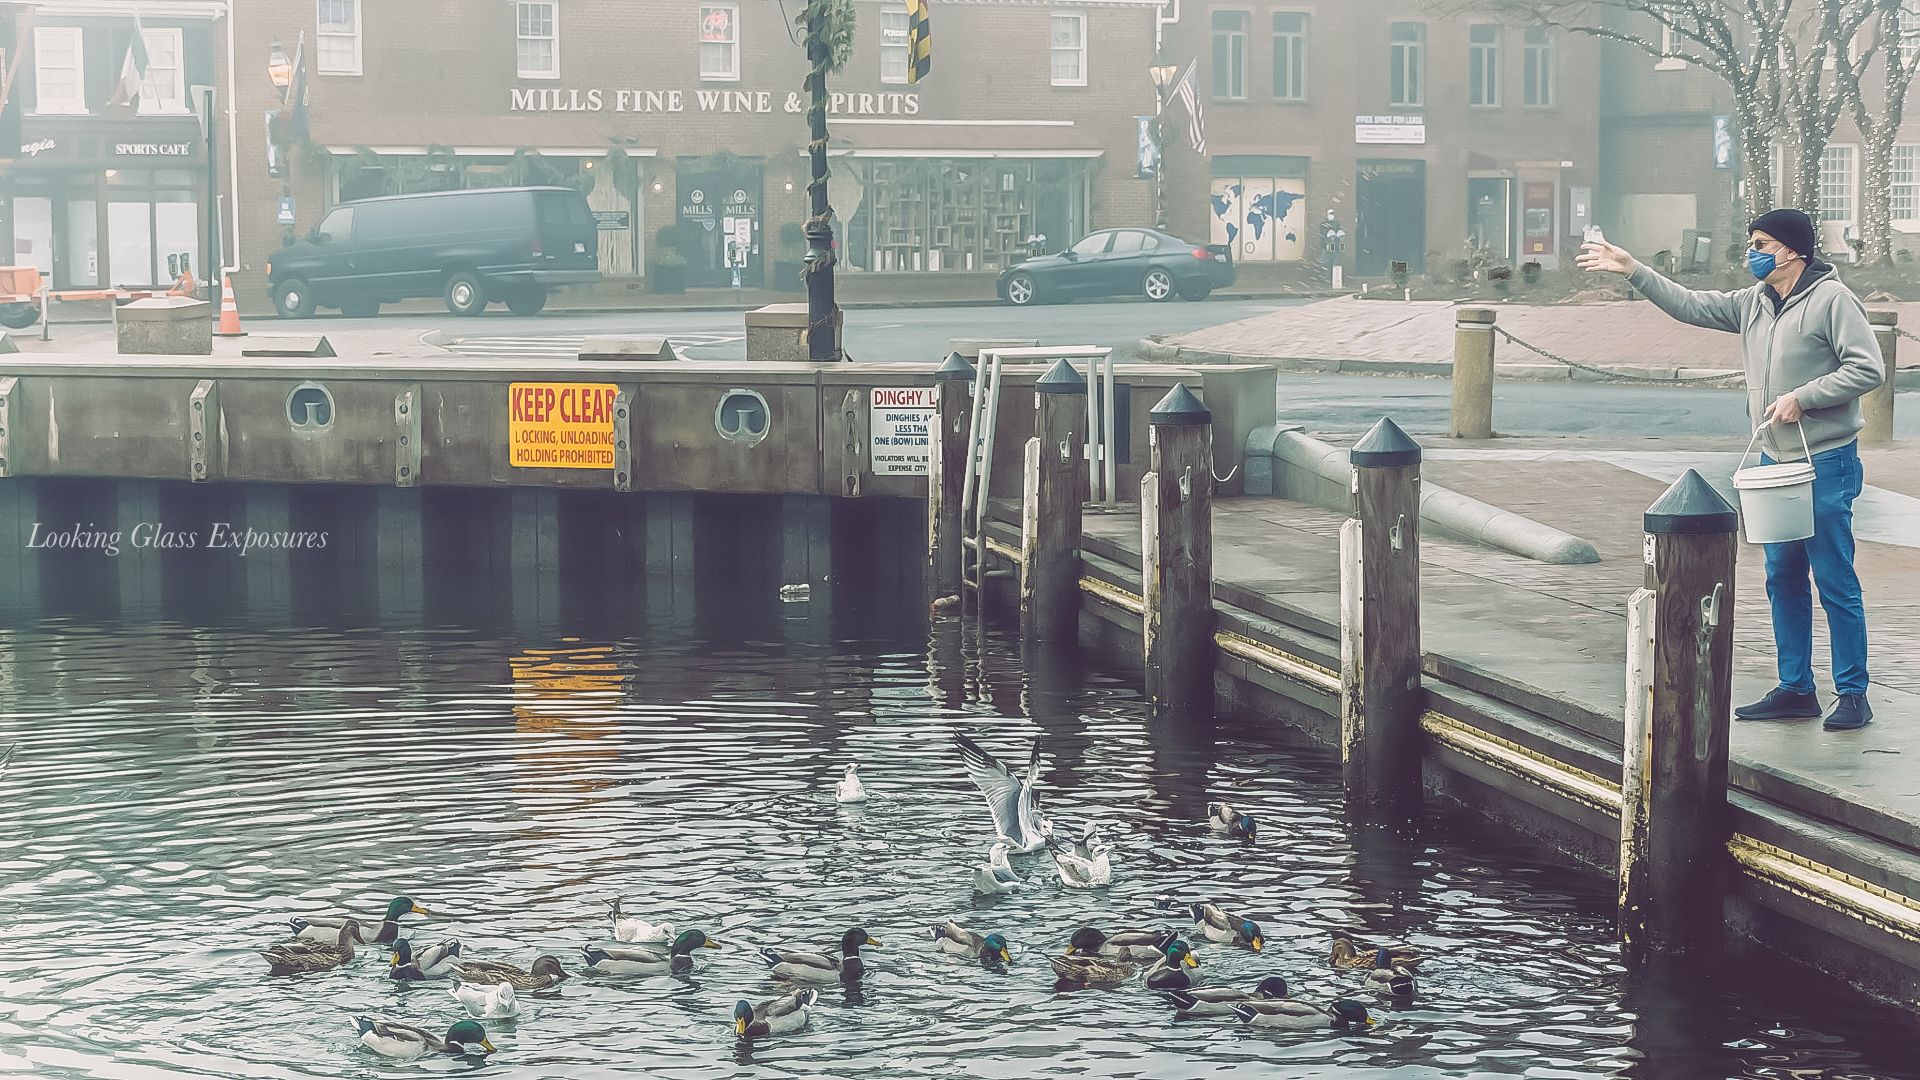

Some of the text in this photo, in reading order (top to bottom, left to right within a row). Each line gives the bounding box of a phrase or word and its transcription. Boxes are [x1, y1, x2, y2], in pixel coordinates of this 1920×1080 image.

[509, 88, 920, 115] MILLS FINE WINE & PIRITS
[116, 143, 158, 155] SPORTS
[682, 205, 713, 215] MILLS
[725, 205, 756, 215] MILLS
[874, 390, 923, 406] DINGHY
[512, 388, 616, 423] KEEP CLEAR
[885, 413, 920, 422] DINGHIES
[895, 425, 912, 433] LESS
[561, 431, 615, 445] UNLOADING
[874, 437, 929, 447] ONE (BOW) LIN
[516, 448, 614, 464] HOLDING PROHIBITED
